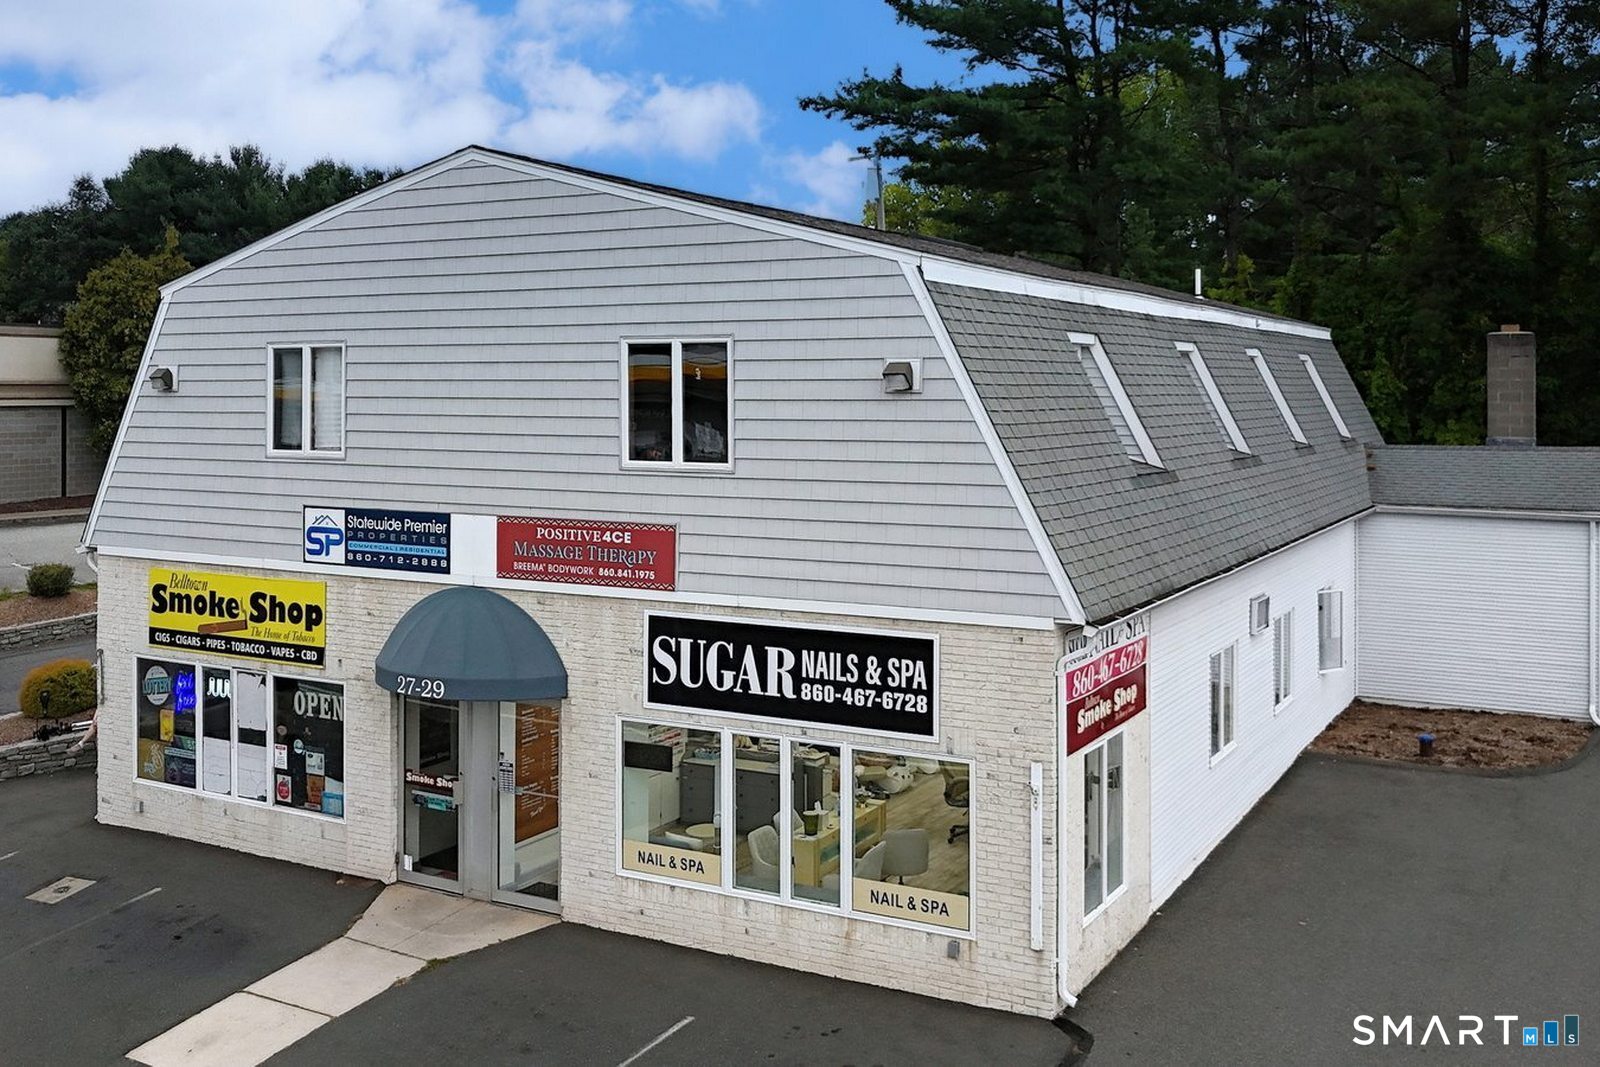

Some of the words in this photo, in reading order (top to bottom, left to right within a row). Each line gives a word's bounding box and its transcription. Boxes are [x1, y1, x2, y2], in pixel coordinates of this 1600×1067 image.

[347, 515, 402, 531] Statewide
[404, 518, 448, 534] Premier
[347, 530, 447, 545] PROPERTIES
[514, 540, 583, 560] MASSAGE
[548, 563, 594, 575] BODYWORK
[598, 567, 655, 580] 860.841.1975
[151, 583, 240, 620] Smoke
[249, 591, 323, 632] Shop
[250, 626, 262, 637] The
[155, 632, 171, 643] CIGS
[175, 633, 201, 647] CIGARS
[206, 638, 226, 650] PIPES
[231, 641, 266, 655] TOBACCO
[270, 646, 295, 659] VAPES
[301, 650, 318, 661] CBD
[652, 635, 797, 699] SUGAR
[801, 649, 859, 684] NAILS
[865, 655, 882, 686] &
[887, 656, 928, 691] SPA
[397, 675, 445, 699] 27-29
[801, 683, 928, 713] 860-467-6728
[293, 690, 344, 722] OPEN
[1077, 698, 1112, 734] Smoke
[1113, 684, 1138, 712] Shop
[405, 772, 435, 786] Smoke
[436, 777, 453, 788] Sho
[637, 850, 666, 868] NAIL
[668, 857, 678, 870] &
[680, 857, 705, 875] SPA
[870, 889, 904, 909] NAIL
[907, 896, 917, 911] &
[920, 898, 950, 917] SPA
